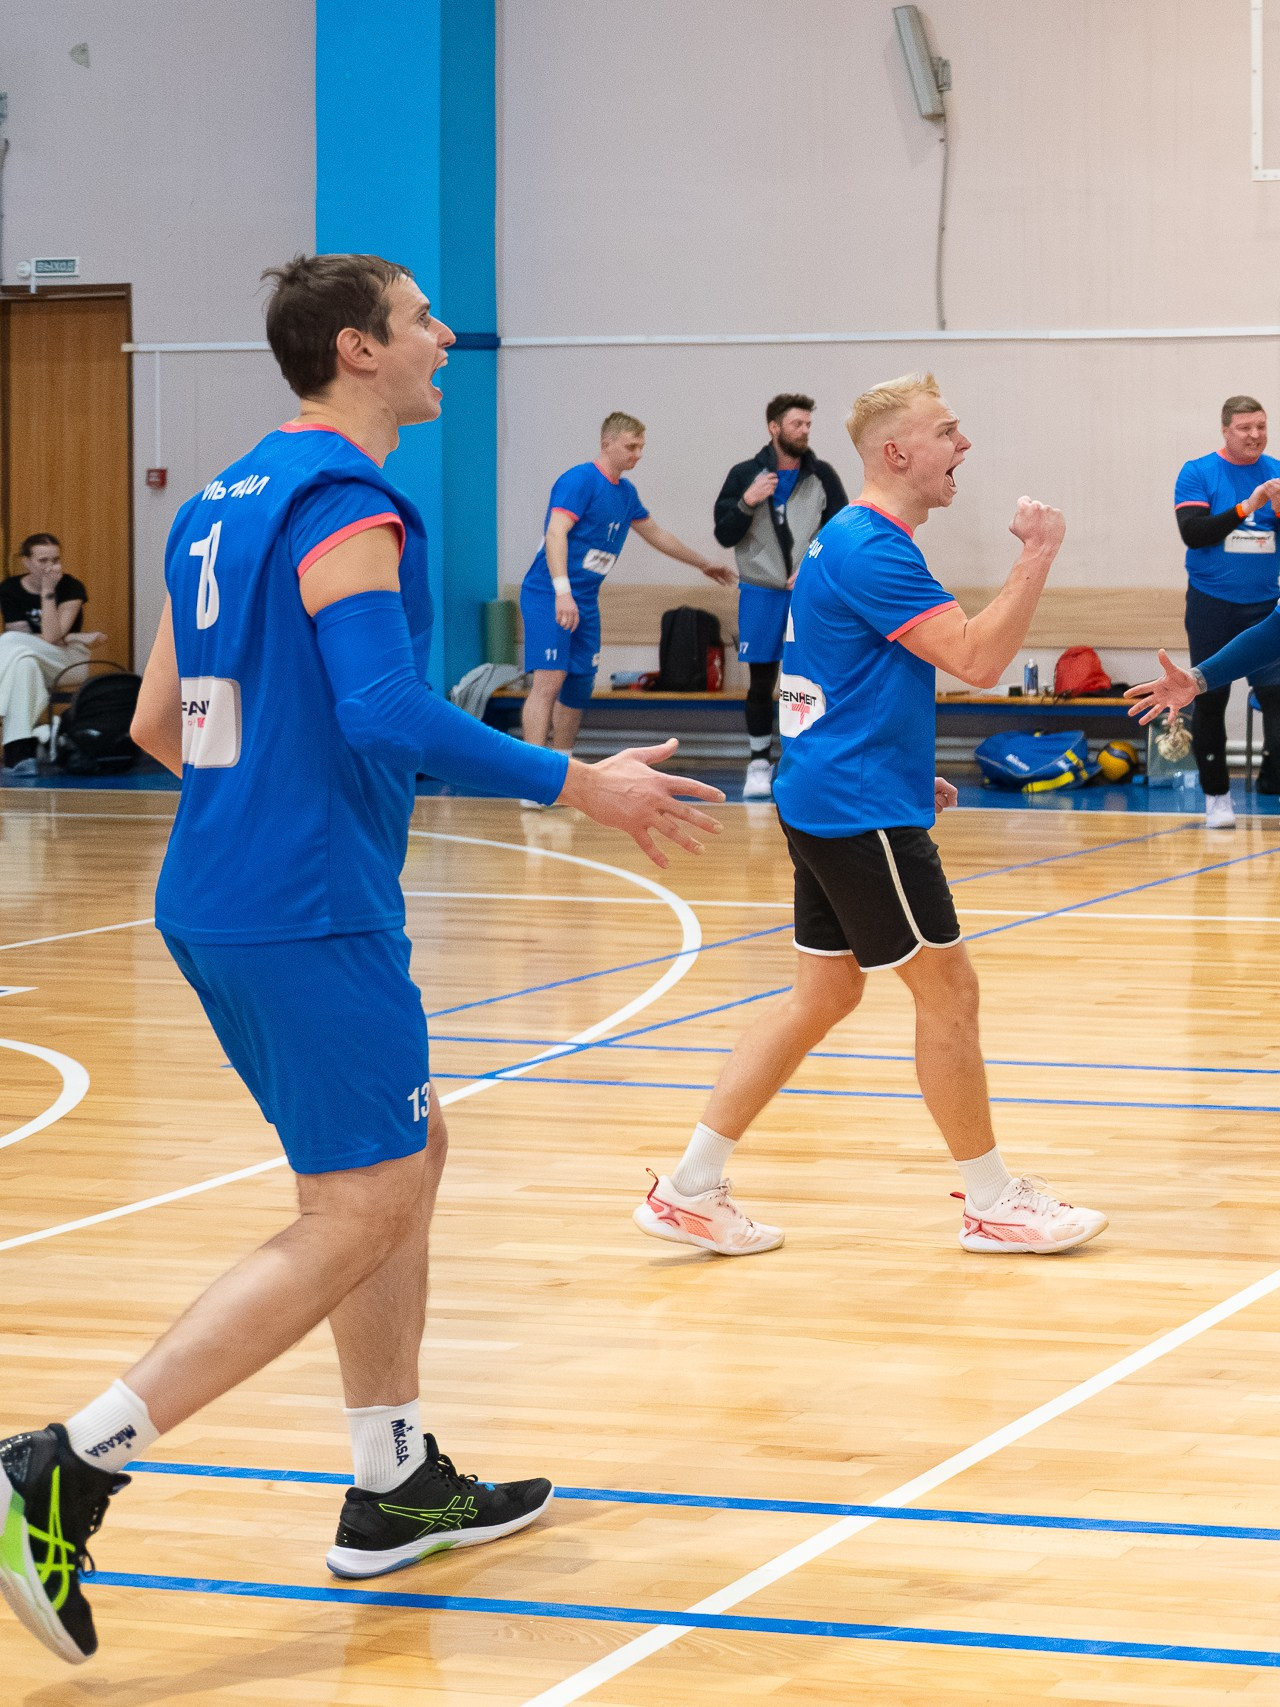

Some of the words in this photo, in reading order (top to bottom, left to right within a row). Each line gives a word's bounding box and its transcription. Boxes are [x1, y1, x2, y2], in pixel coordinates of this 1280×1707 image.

[545, 648, 558, 662] 11
[779, 688, 817, 707] ENHEIT
[407, 1081, 430, 1122] 13
